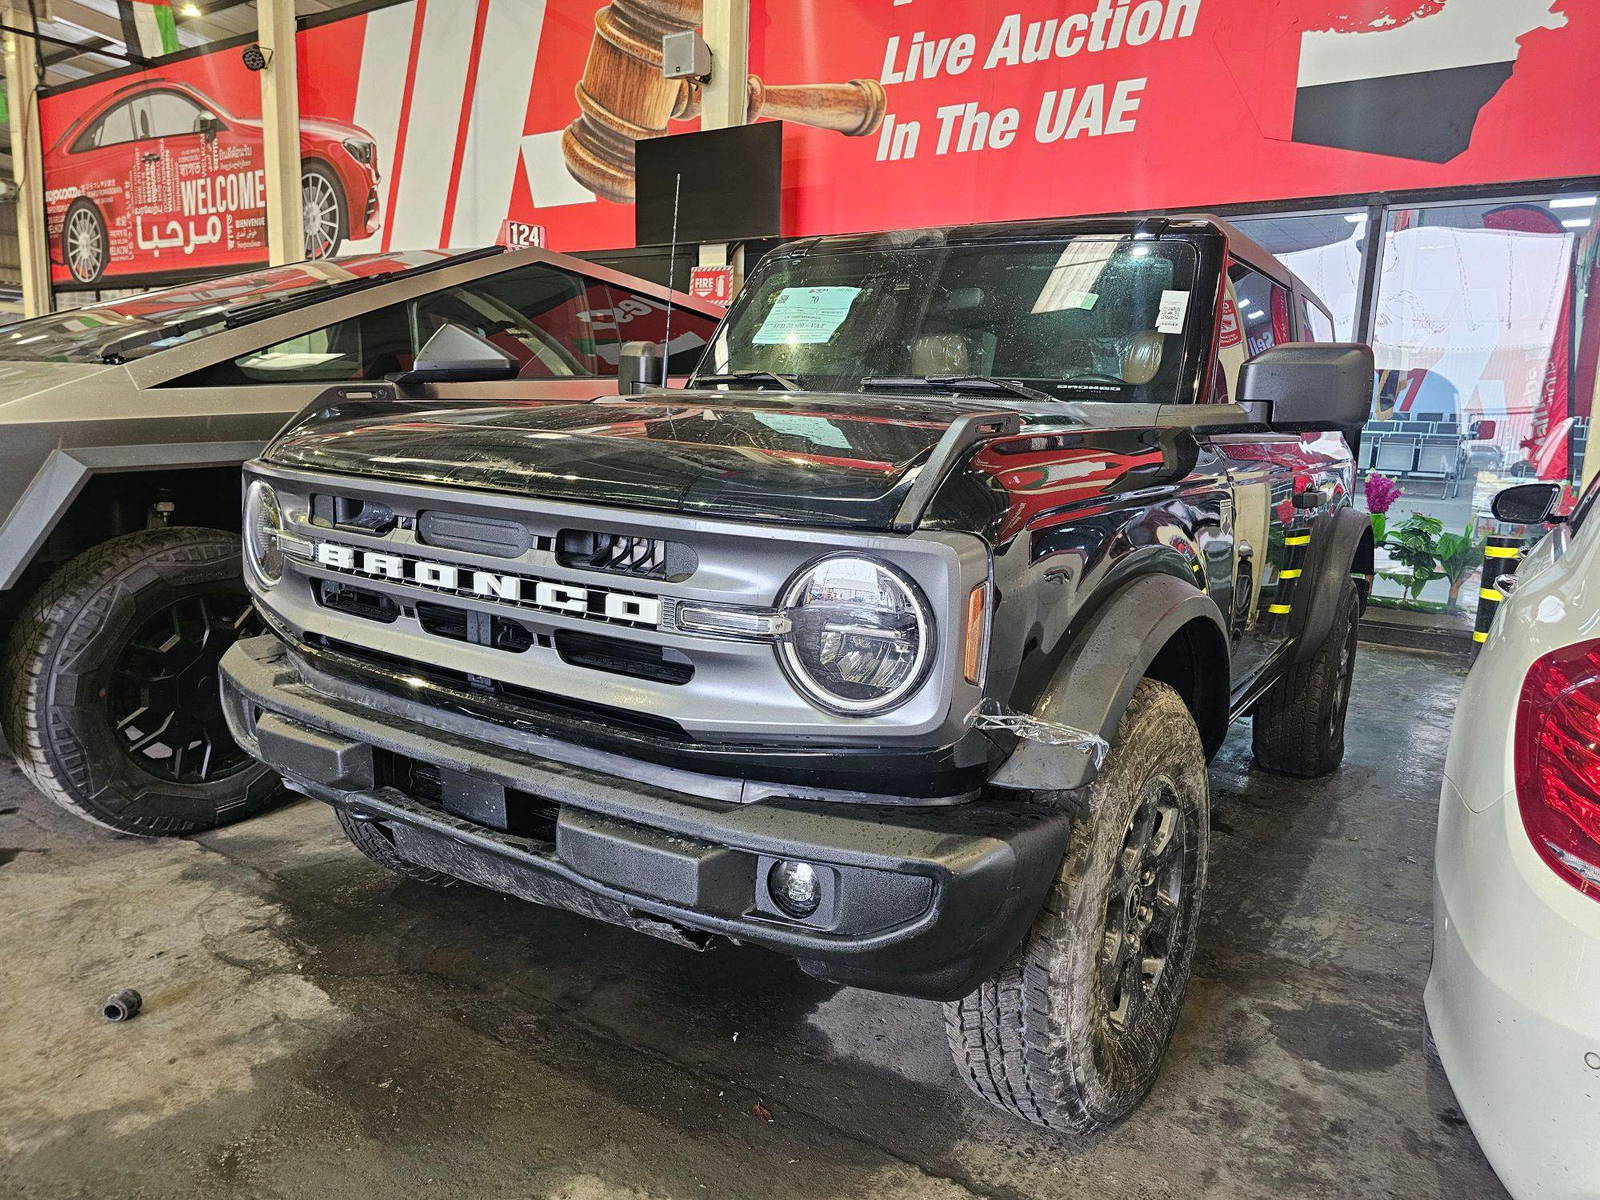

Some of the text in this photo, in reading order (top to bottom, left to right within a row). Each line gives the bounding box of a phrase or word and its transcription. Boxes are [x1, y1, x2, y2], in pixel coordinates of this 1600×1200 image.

[880, 0, 1201, 85] Live Auction
[875, 77, 1148, 161] In The UAE
[180, 169, 265, 216] WELCOME
[135, 215, 222, 257] مرحبا
[511, 223, 539, 247] 124
[695, 277, 714, 288] FIRE
[318, 543, 661, 625] BRONCO
